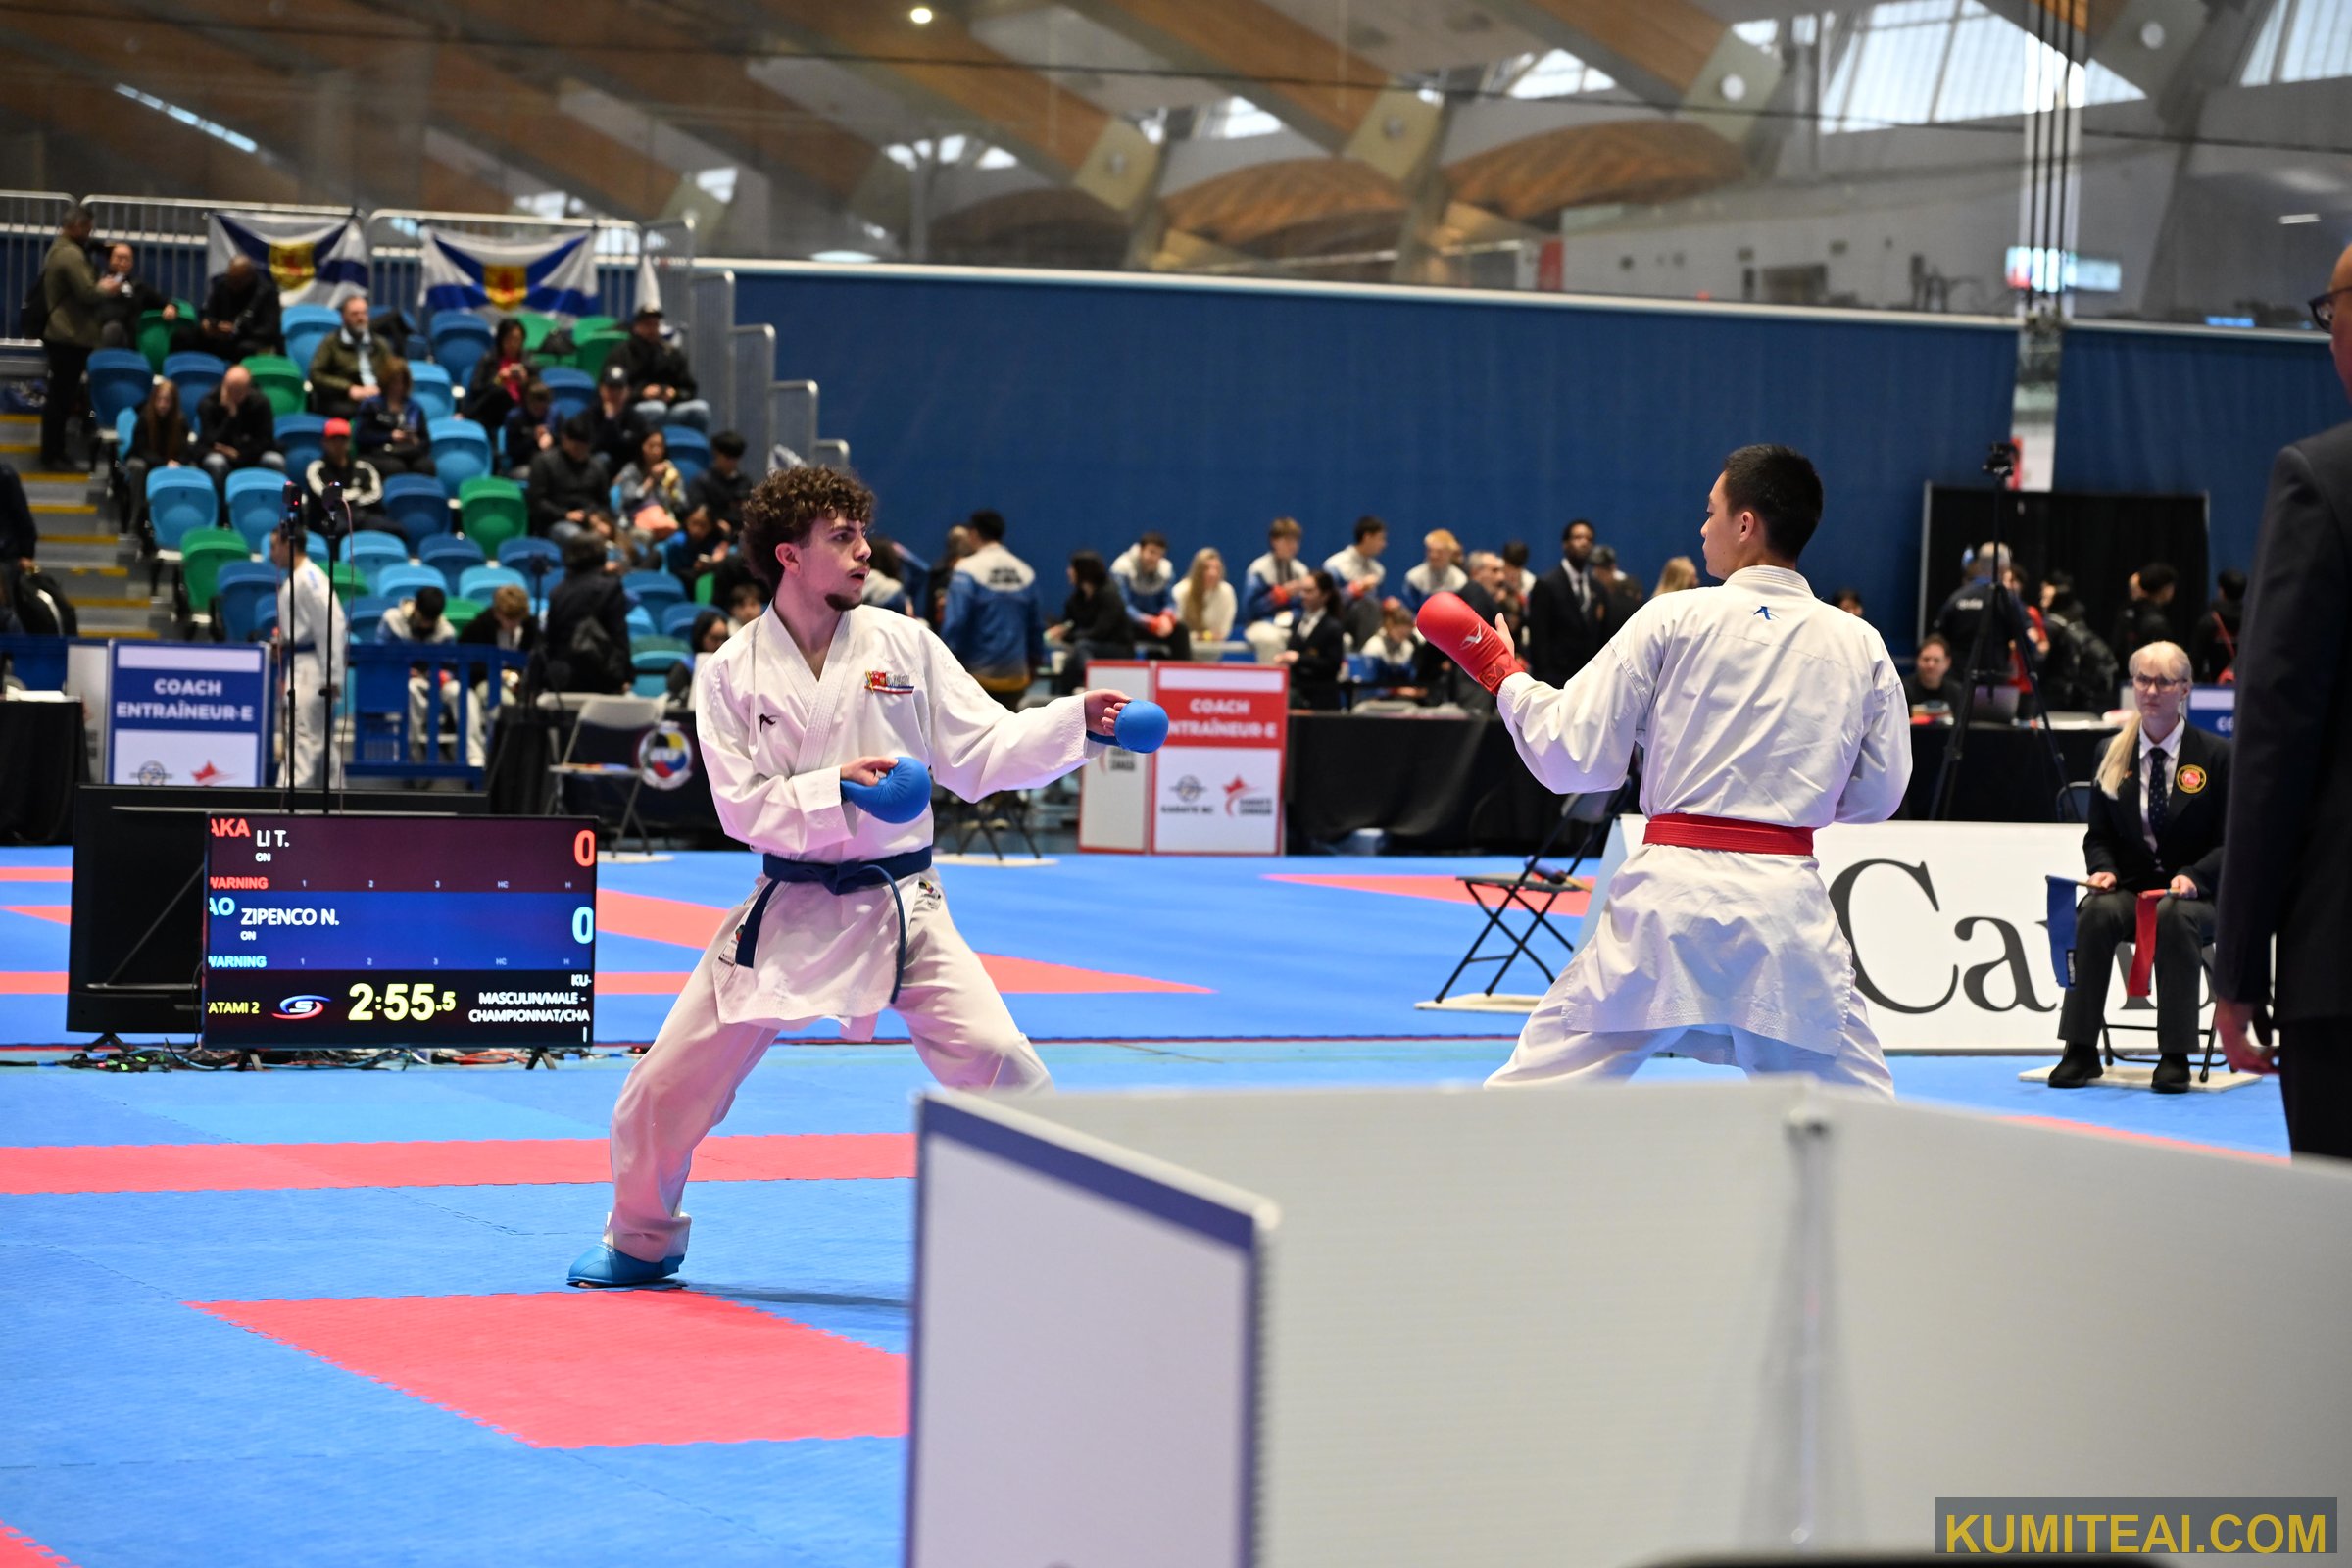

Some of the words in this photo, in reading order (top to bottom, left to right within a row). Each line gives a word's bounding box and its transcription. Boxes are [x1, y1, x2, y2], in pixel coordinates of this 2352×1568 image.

[154, 678, 223, 697] COACH
[1189, 698, 1250, 715] COACH
[256, 829, 270, 848] LI
[274, 829, 290, 848] T.
[574, 829, 595, 867] 0
[255, 852, 271, 862] ON
[368, 879, 374, 888] 2
[240, 908, 318, 926] ZIPENCO
[320, 908, 340, 926] N.
[571, 906, 594, 944] 0
[240, 931, 257, 941] ON
[300, 957, 305, 966] 1
[367, 957, 372, 966] 2
[433, 957, 439, 966] 3
[478, 992, 578, 1005] MASCULIN/MALE
[207, 1002, 249, 1015] ATAMI
[251, 1002, 261, 1015] 2
[468, 1009, 590, 1023] CHAMPIONNAT/CHA
